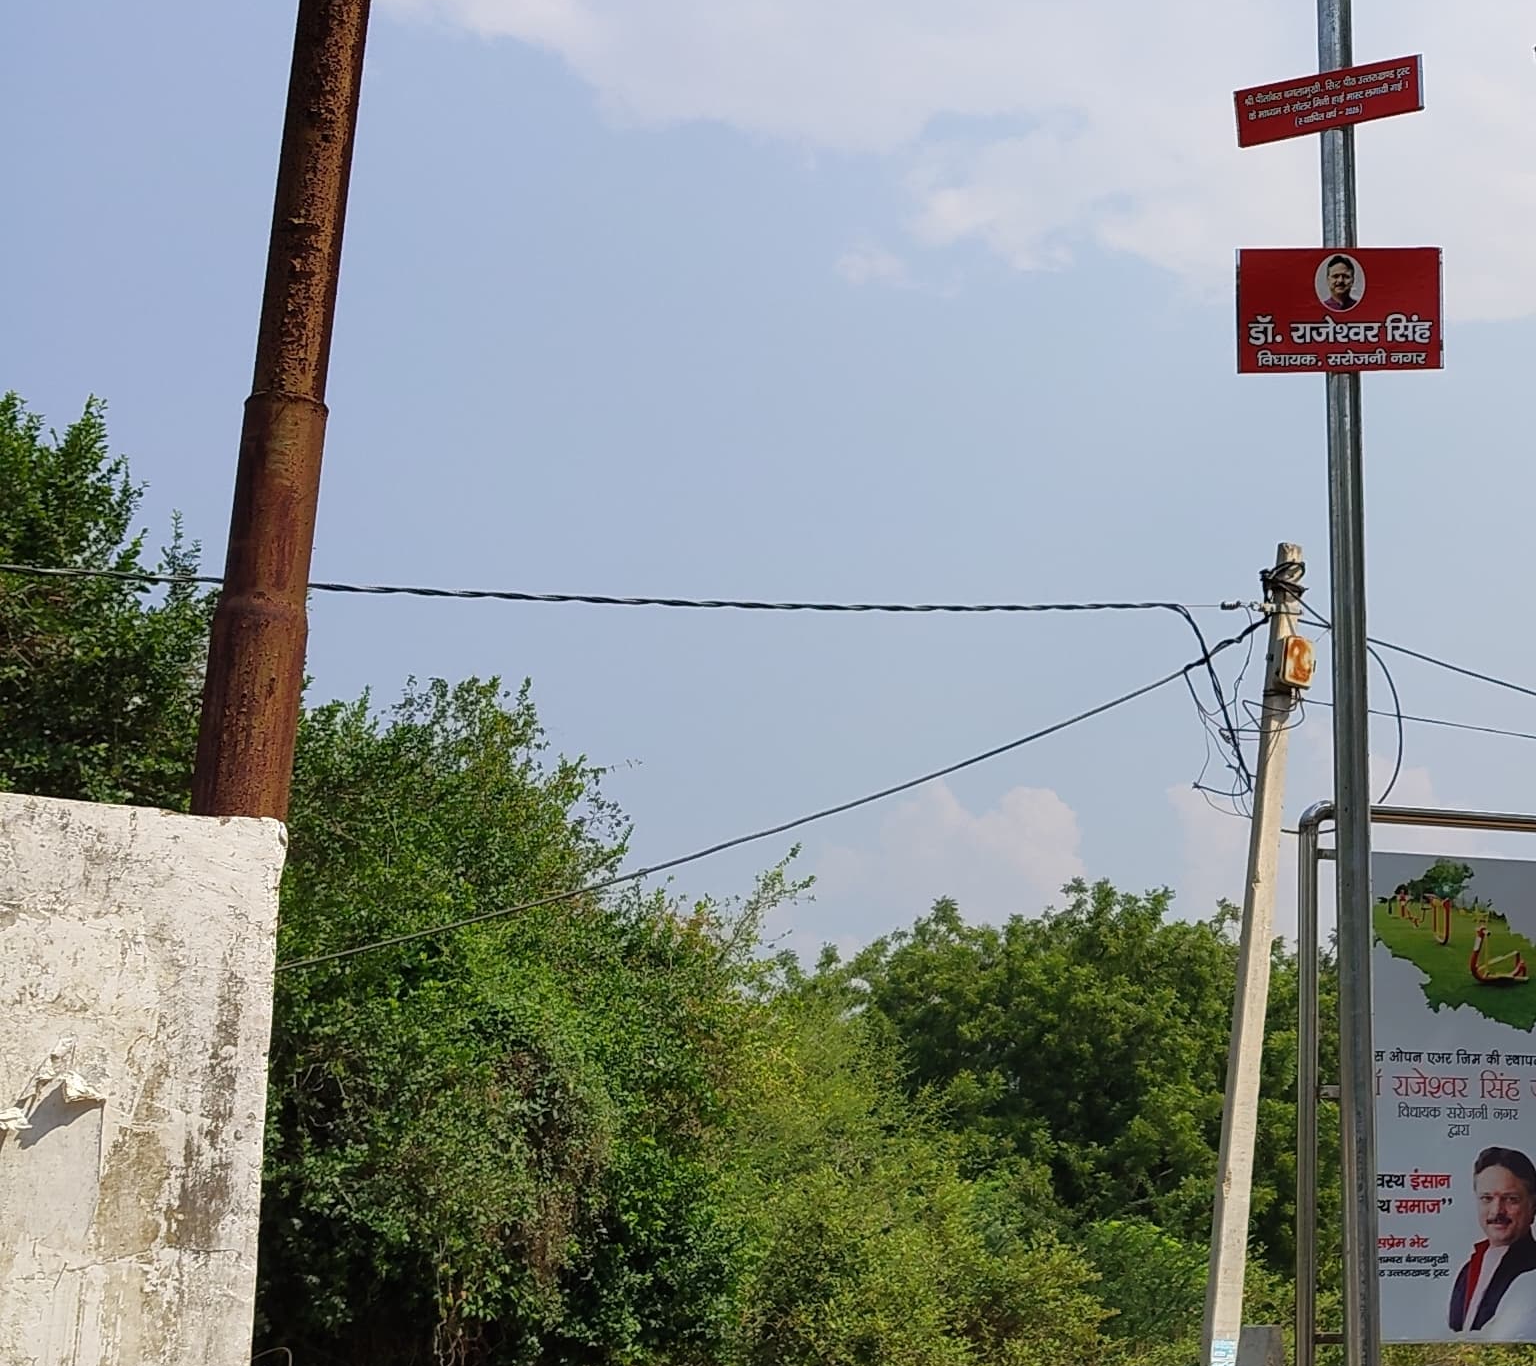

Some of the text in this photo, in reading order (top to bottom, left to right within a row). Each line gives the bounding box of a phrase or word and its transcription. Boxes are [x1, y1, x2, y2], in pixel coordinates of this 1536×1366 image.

[1248, 314, 1432, 345] डॉ. राजेश्वर सिंह
[1327, 348, 1386, 366] सरोजनी
[1390, 352, 1427, 365] नगर
[1389, 1047, 1424, 1063] ओपन
[1456, 1048, 1483, 1065] जिम
[1485, 1049, 1502, 1066] की
[1392, 1067, 1469, 1099] राजेश्वर
[1480, 1069, 1520, 1101] सिंह
[1398, 1101, 1519, 1120] विधायक सरोजनी नगर
[1448, 1123, 1470, 1138] द्वारा
[1409, 1169, 1452, 1191] इंसान
